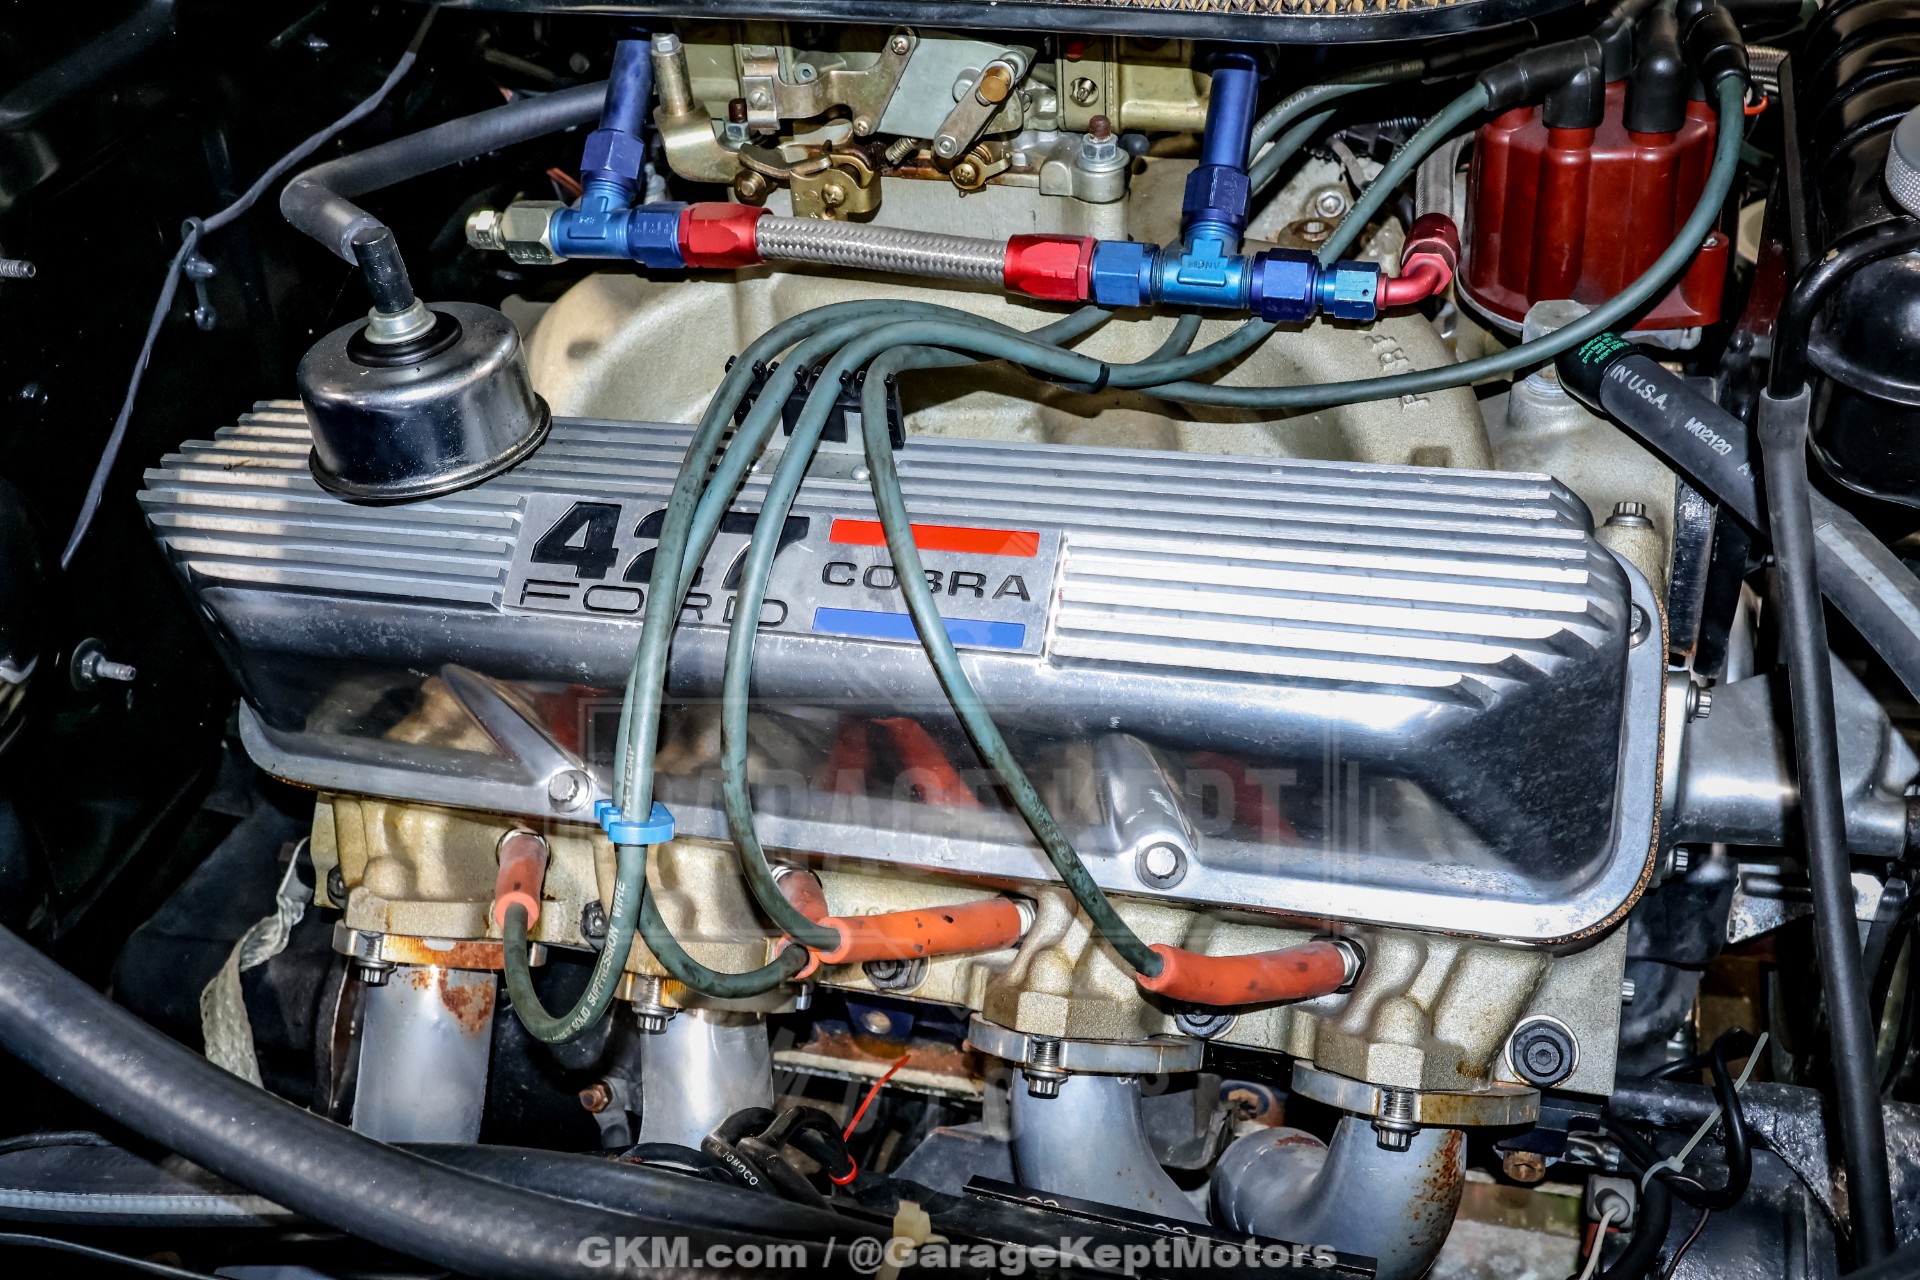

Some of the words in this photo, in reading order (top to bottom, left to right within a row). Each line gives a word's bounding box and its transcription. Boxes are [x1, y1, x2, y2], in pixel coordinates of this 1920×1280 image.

[1610, 364, 1632, 384] IN
[1627, 374, 1668, 411] U.S.A.
[1684, 417, 1733, 456] M02120
[519, 578, 789, 627] FORD
[821, 561, 1031, 602] COBRA
[571, 1005, 591, 1031] SOLID
[587, 923, 620, 1007] SUPPRESSION
[612, 880, 626, 918] WIRE
